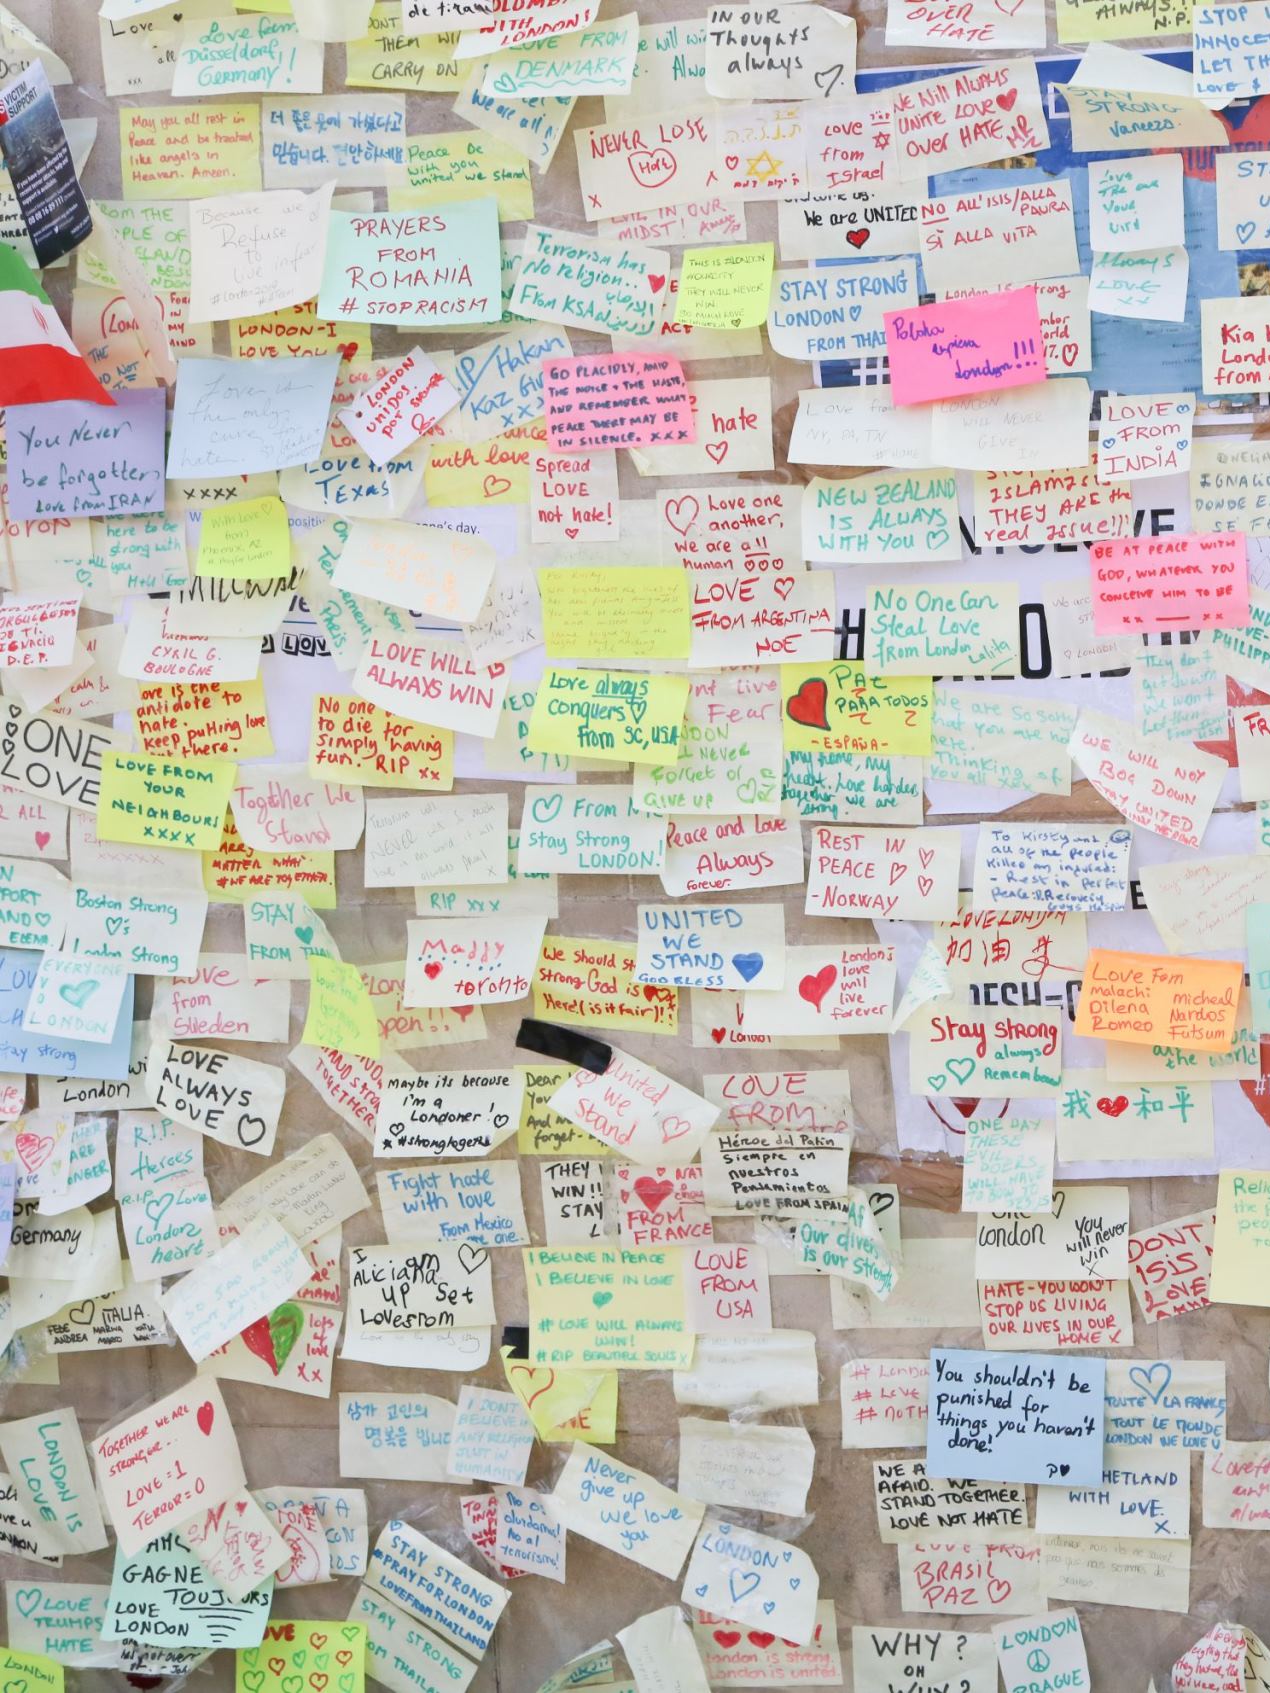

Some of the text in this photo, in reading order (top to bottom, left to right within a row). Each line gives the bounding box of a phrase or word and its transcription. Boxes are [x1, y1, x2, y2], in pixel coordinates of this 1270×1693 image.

[712, 9, 780, 25] IN OUR
[728, 54, 802, 76] always
[350, 216, 446, 238] PRAYERS
[377, 248, 435, 262] FROM
[346, 265, 472, 290] ROMANIA
[780, 271, 908, 301] STAY STRONG
[775, 307, 844, 327] LONDON
[1221, 324, 1255, 345] Kia
[550, 367, 570, 380] GO
[1214, 366, 1262, 385] from
[1109, 403, 1173, 421] LOVE
[19, 428, 62, 454] You
[558, 438, 572, 447] IN
[543, 482, 589, 497] LOVE
[817, 479, 957, 507] NEW ZEALAND
[539, 508, 563, 522] not
[868, 508, 947, 530] ALWAYS
[694, 578, 759, 604] LOVE
[692, 610, 744, 631] FROM
[871, 614, 927, 637] Steal
[370, 641, 476, 675] LOVE WILL
[367, 665, 494, 709] ALWAYS WIN
[115, 758, 212, 783] LOVE FROM
[376, 754, 409, 773] RIP
[144, 781, 185, 798] YOUR
[817, 829, 905, 853] REST IN
[819, 857, 875, 878] PEACE
[645, 909, 743, 930] UNITED
[663, 934, 701, 949] WE
[651, 953, 723, 969] STAND
[1092, 1015, 1153, 1032] Romeo
[931, 1015, 987, 1057] Stay
[167, 1045, 228, 1074] LOVE
[64, 1080, 130, 1102] London
[162, 1068, 251, 1109] ALWAYS
[156, 1087, 225, 1129] LOVE
[449, 1170, 493, 1187] hate
[459, 1192, 496, 1208] love
[695, 1250, 748, 1271] LOVE
[701, 1276, 757, 1294] FROM
[716, 1300, 753, 1318] USA
[935, 1359, 1091, 1393] You shouldn't be
[937, 1392, 1050, 1415] punished for
[937, 1412, 1096, 1436] things you haven't
[948, 1434, 993, 1453] done!
[622, 1492, 645, 1505] up
[889, 1508, 1022, 1529] LOVE NOT HATE
[702, 1533, 779, 1568] LONDON
[123, 1564, 203, 1583] GAGNE
[391, 1537, 492, 1608] STAY STRONG
[44, 1597, 91, 1611] LOVE
[115, 1619, 189, 1635] LONDON
[46, 1637, 93, 1653] HATE
[872, 1632, 941, 1660] WHY
